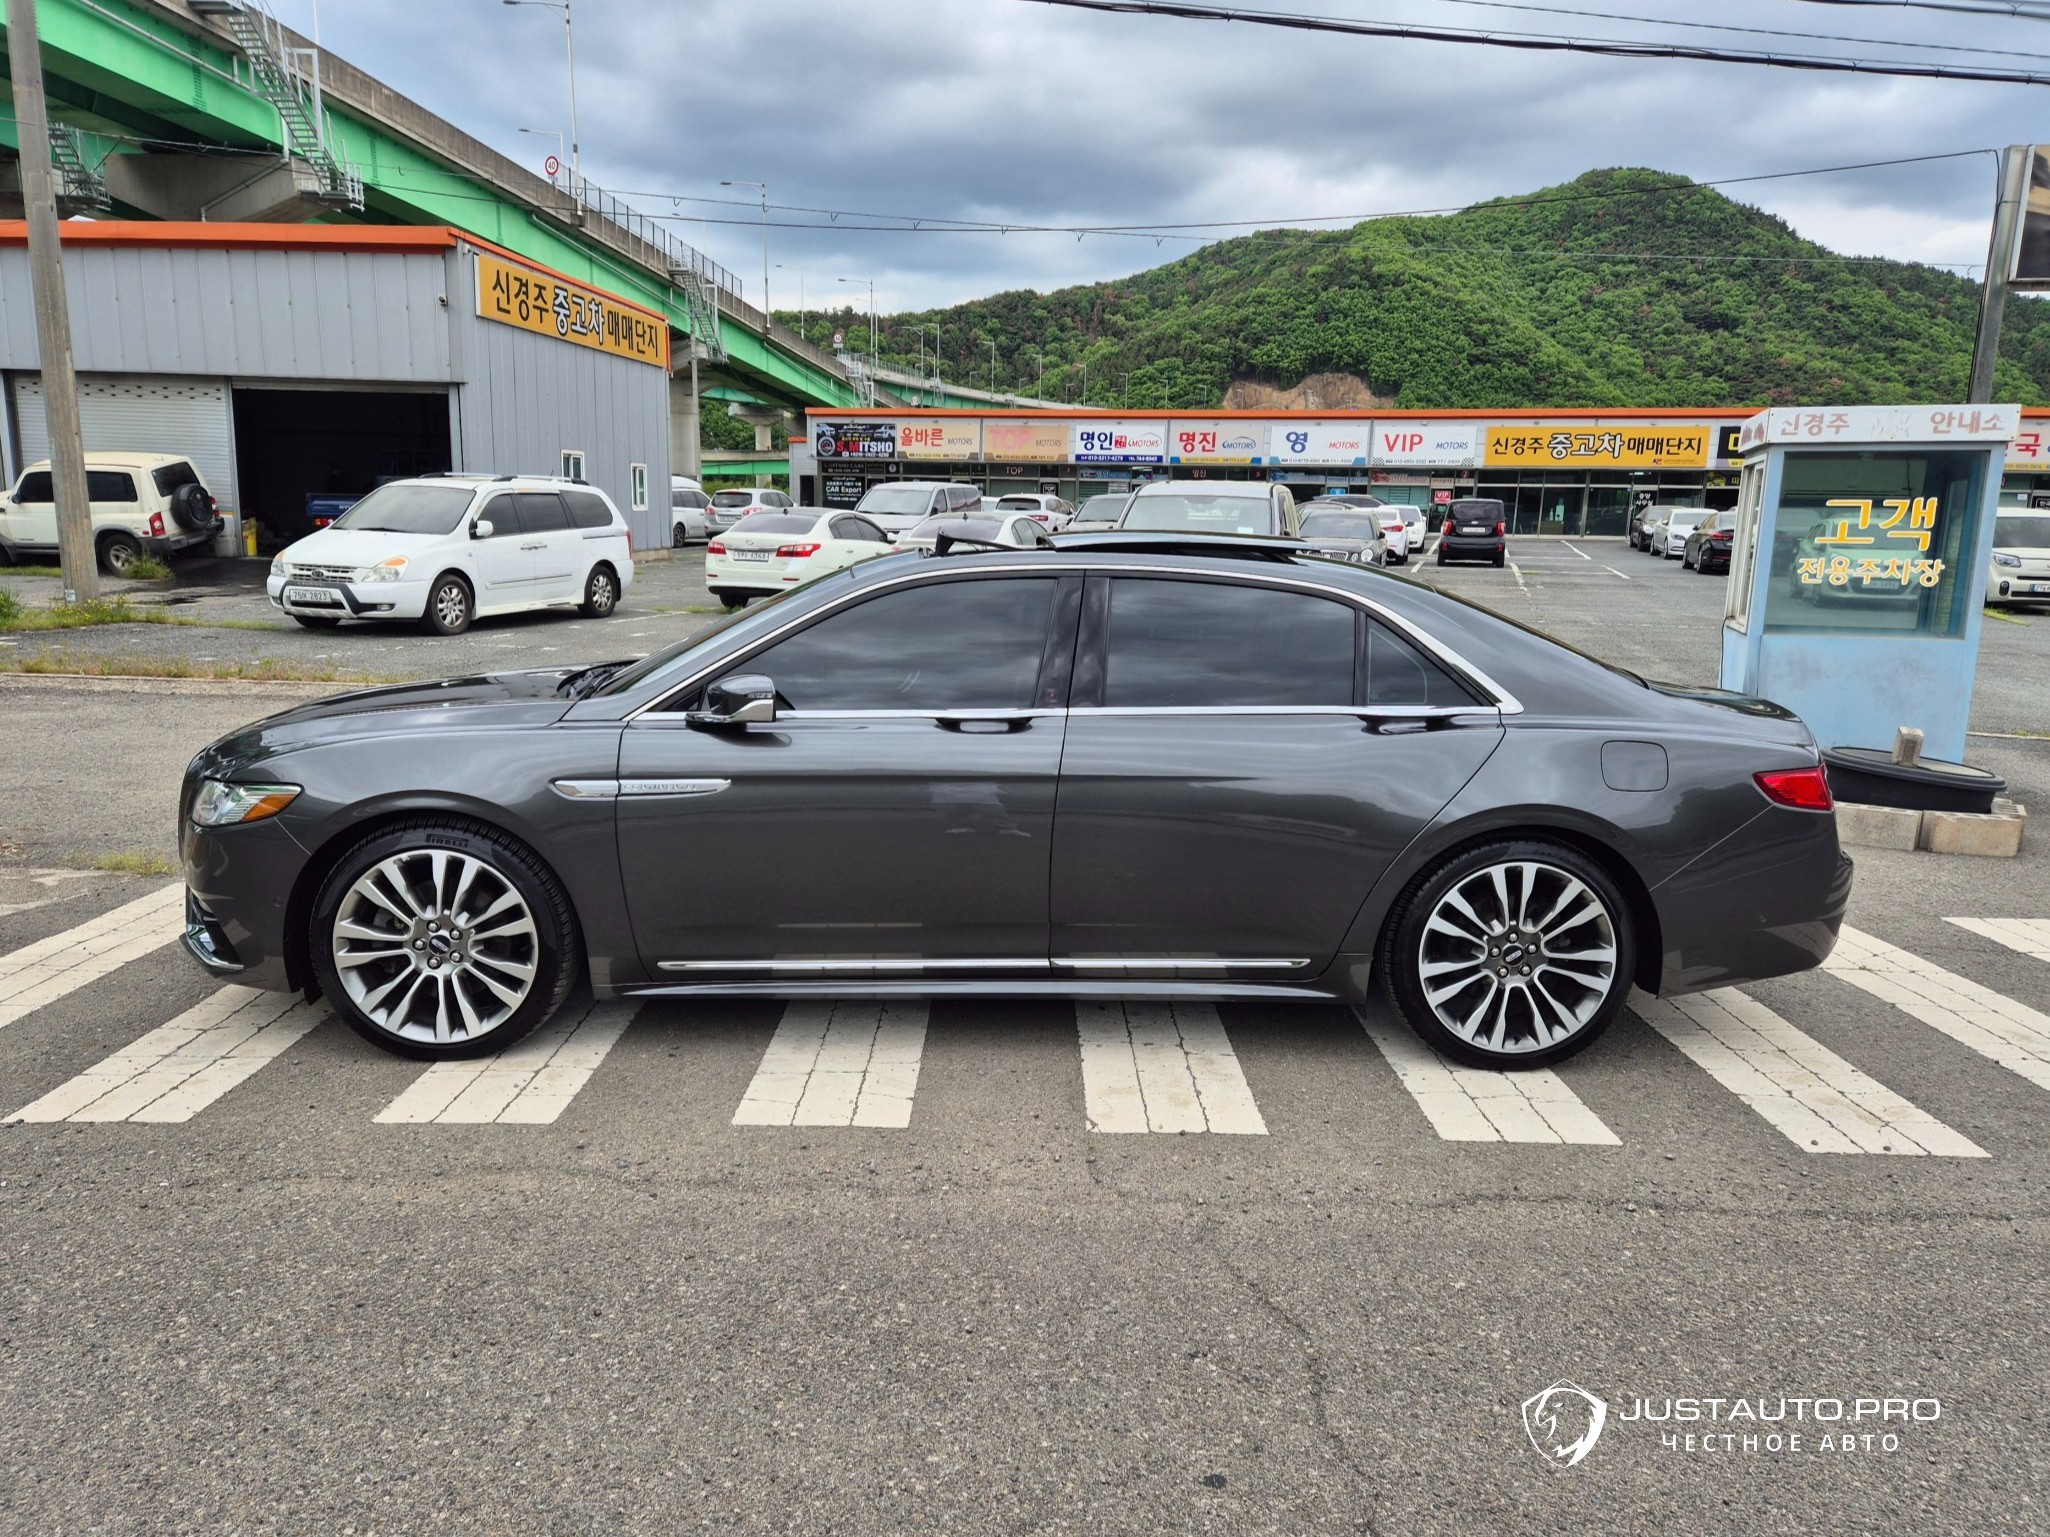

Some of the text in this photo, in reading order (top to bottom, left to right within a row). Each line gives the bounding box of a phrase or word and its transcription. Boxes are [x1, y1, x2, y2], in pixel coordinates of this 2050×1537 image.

[547, 160, 556, 170] 40
[492, 269, 659, 358] 신경주 중고차 매매단지
[1780, 412, 1850, 437] 신경주
[1929, 410, 2005, 434] 안내소
[900, 427, 973, 447] 올바른 MOTORS
[989, 429, 1062, 450] TOP MOTORS
[1080, 431, 1113, 451] 명인
[1131, 440, 1159, 448] MOTORS
[1179, 432, 1217, 453] 명진
[1285, 431, 1360, 454] 영 MOTORS
[1384, 433, 1469, 453] VIP MOTORS
[1492, 432, 1702, 460] 신경주 중고차 매매단지
[1005, 466, 1024, 475] TOP
[1192, 469, 1207, 478] 명진
[841, 486, 862, 494] Export
[1814, 497, 1938, 552] 고객
[1796, 556, 1946, 588] 전용주차장
[309, 592, 328, 601] 2823
[426, 833, 470, 848] PIRELLI
